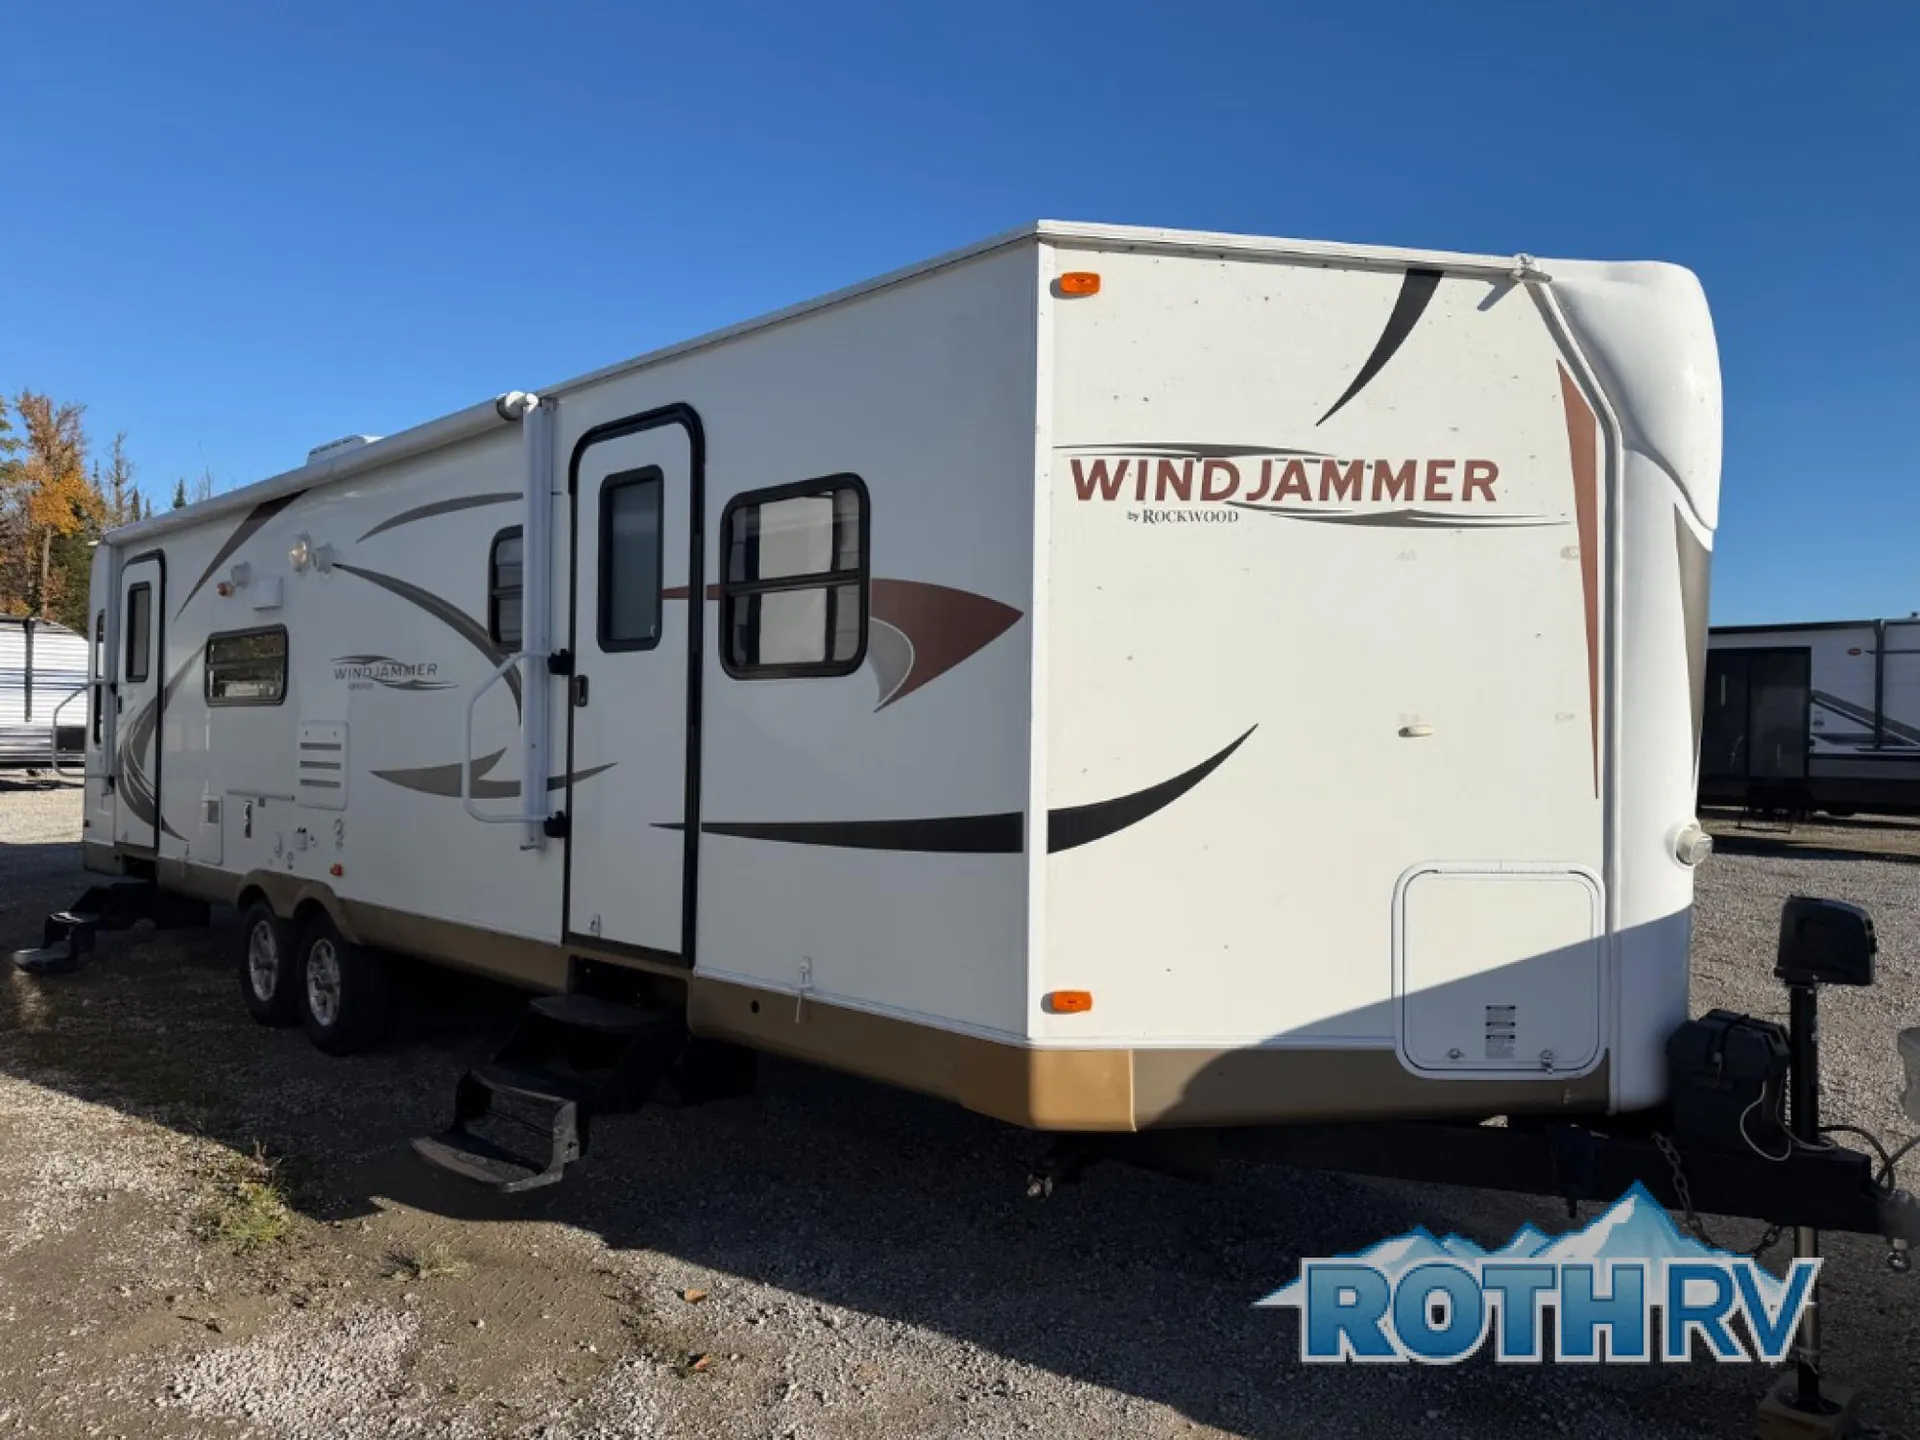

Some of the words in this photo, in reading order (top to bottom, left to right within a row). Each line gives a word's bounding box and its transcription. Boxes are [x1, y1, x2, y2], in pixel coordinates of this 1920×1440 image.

[1070, 458, 1500, 501] WINDJAMMER
[1127, 510, 1140, 522] by
[1143, 509, 1239, 524] ROCKWOOD
[333, 663, 438, 680] WINDJAMMER
